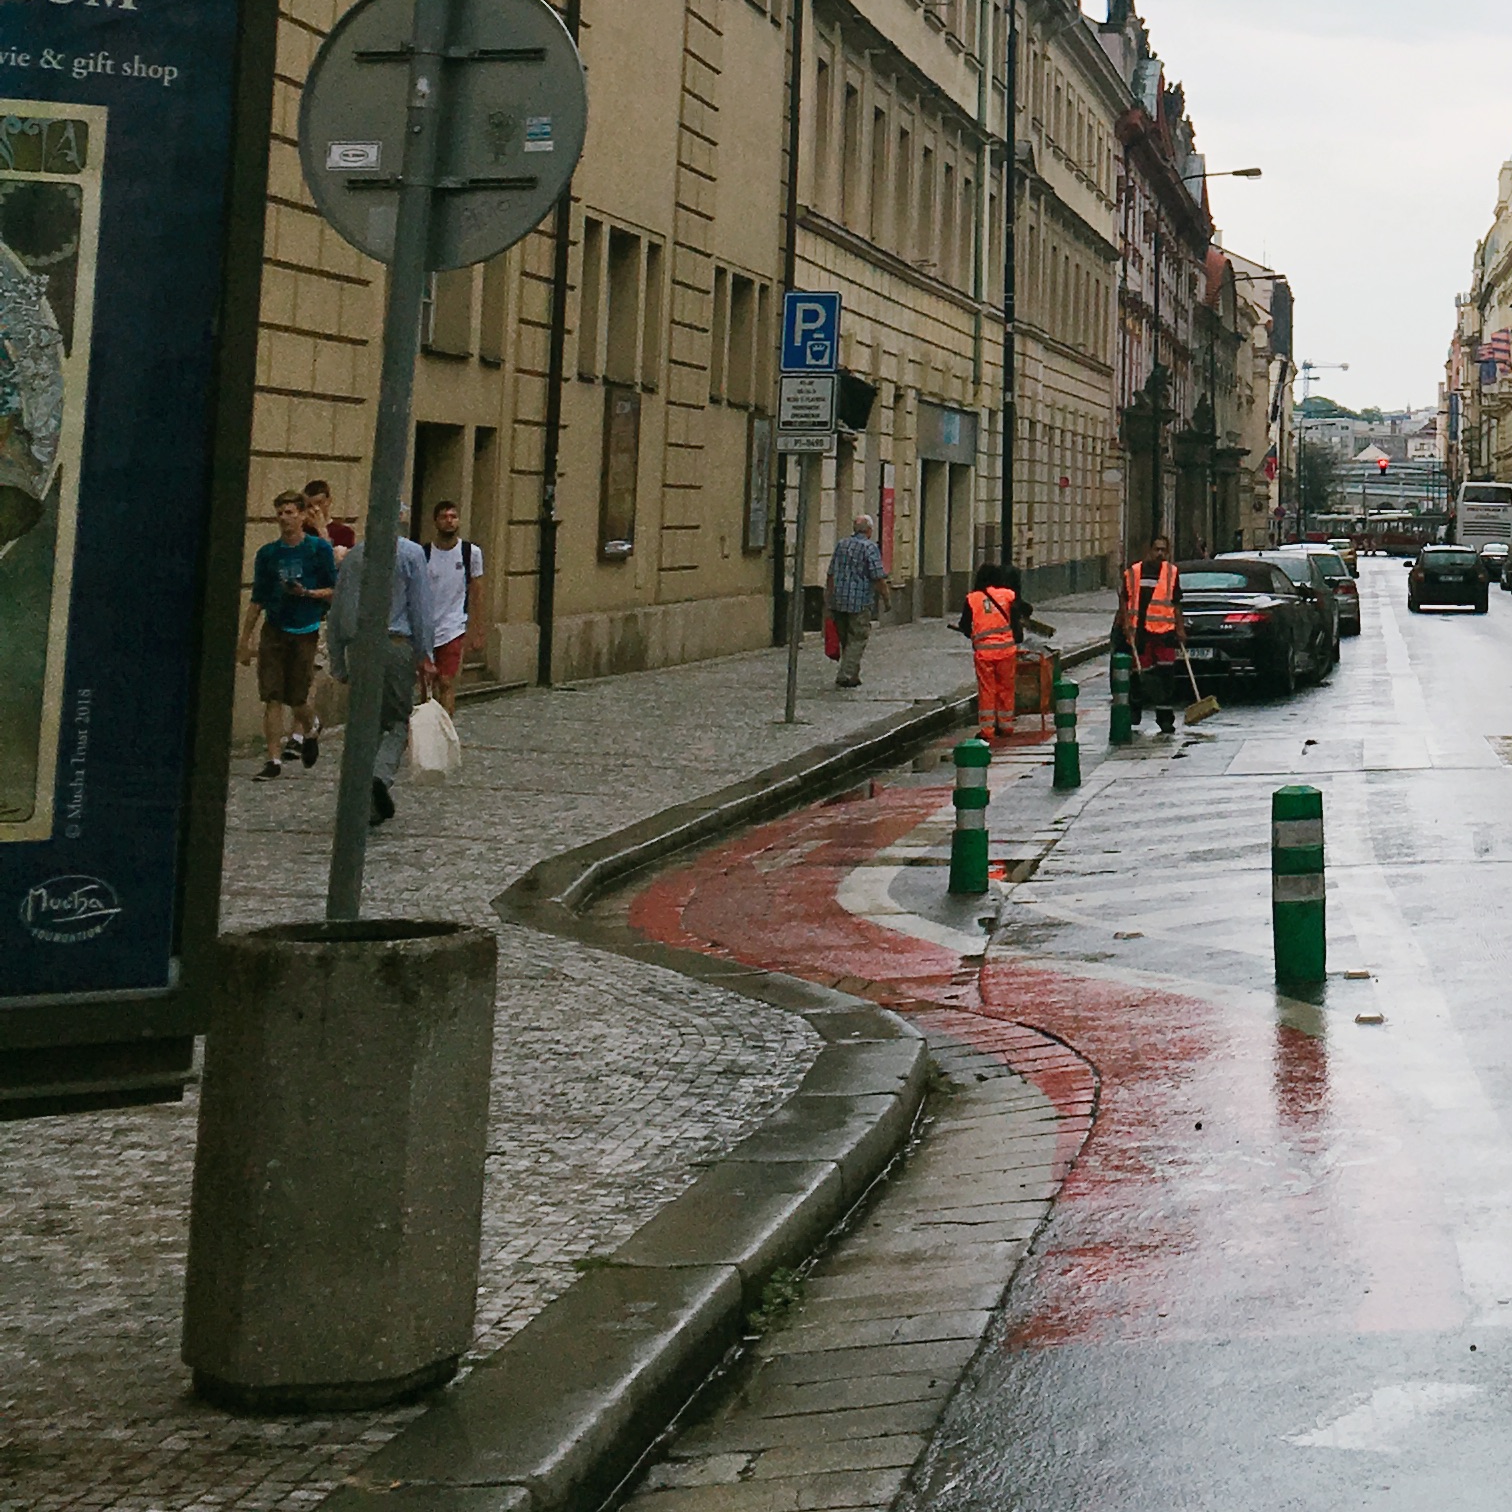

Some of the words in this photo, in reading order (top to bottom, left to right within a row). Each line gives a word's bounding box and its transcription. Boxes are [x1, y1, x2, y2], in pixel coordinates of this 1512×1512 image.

[39, 48, 65, 70] &
[72, 50, 115, 79] gift
[121, 55, 178, 87] shop
[794, 303, 826, 346] P
[70, 729, 88, 765] Trust
[66, 769, 85, 819] Mucha
[27, 884, 105, 922] Mucha
